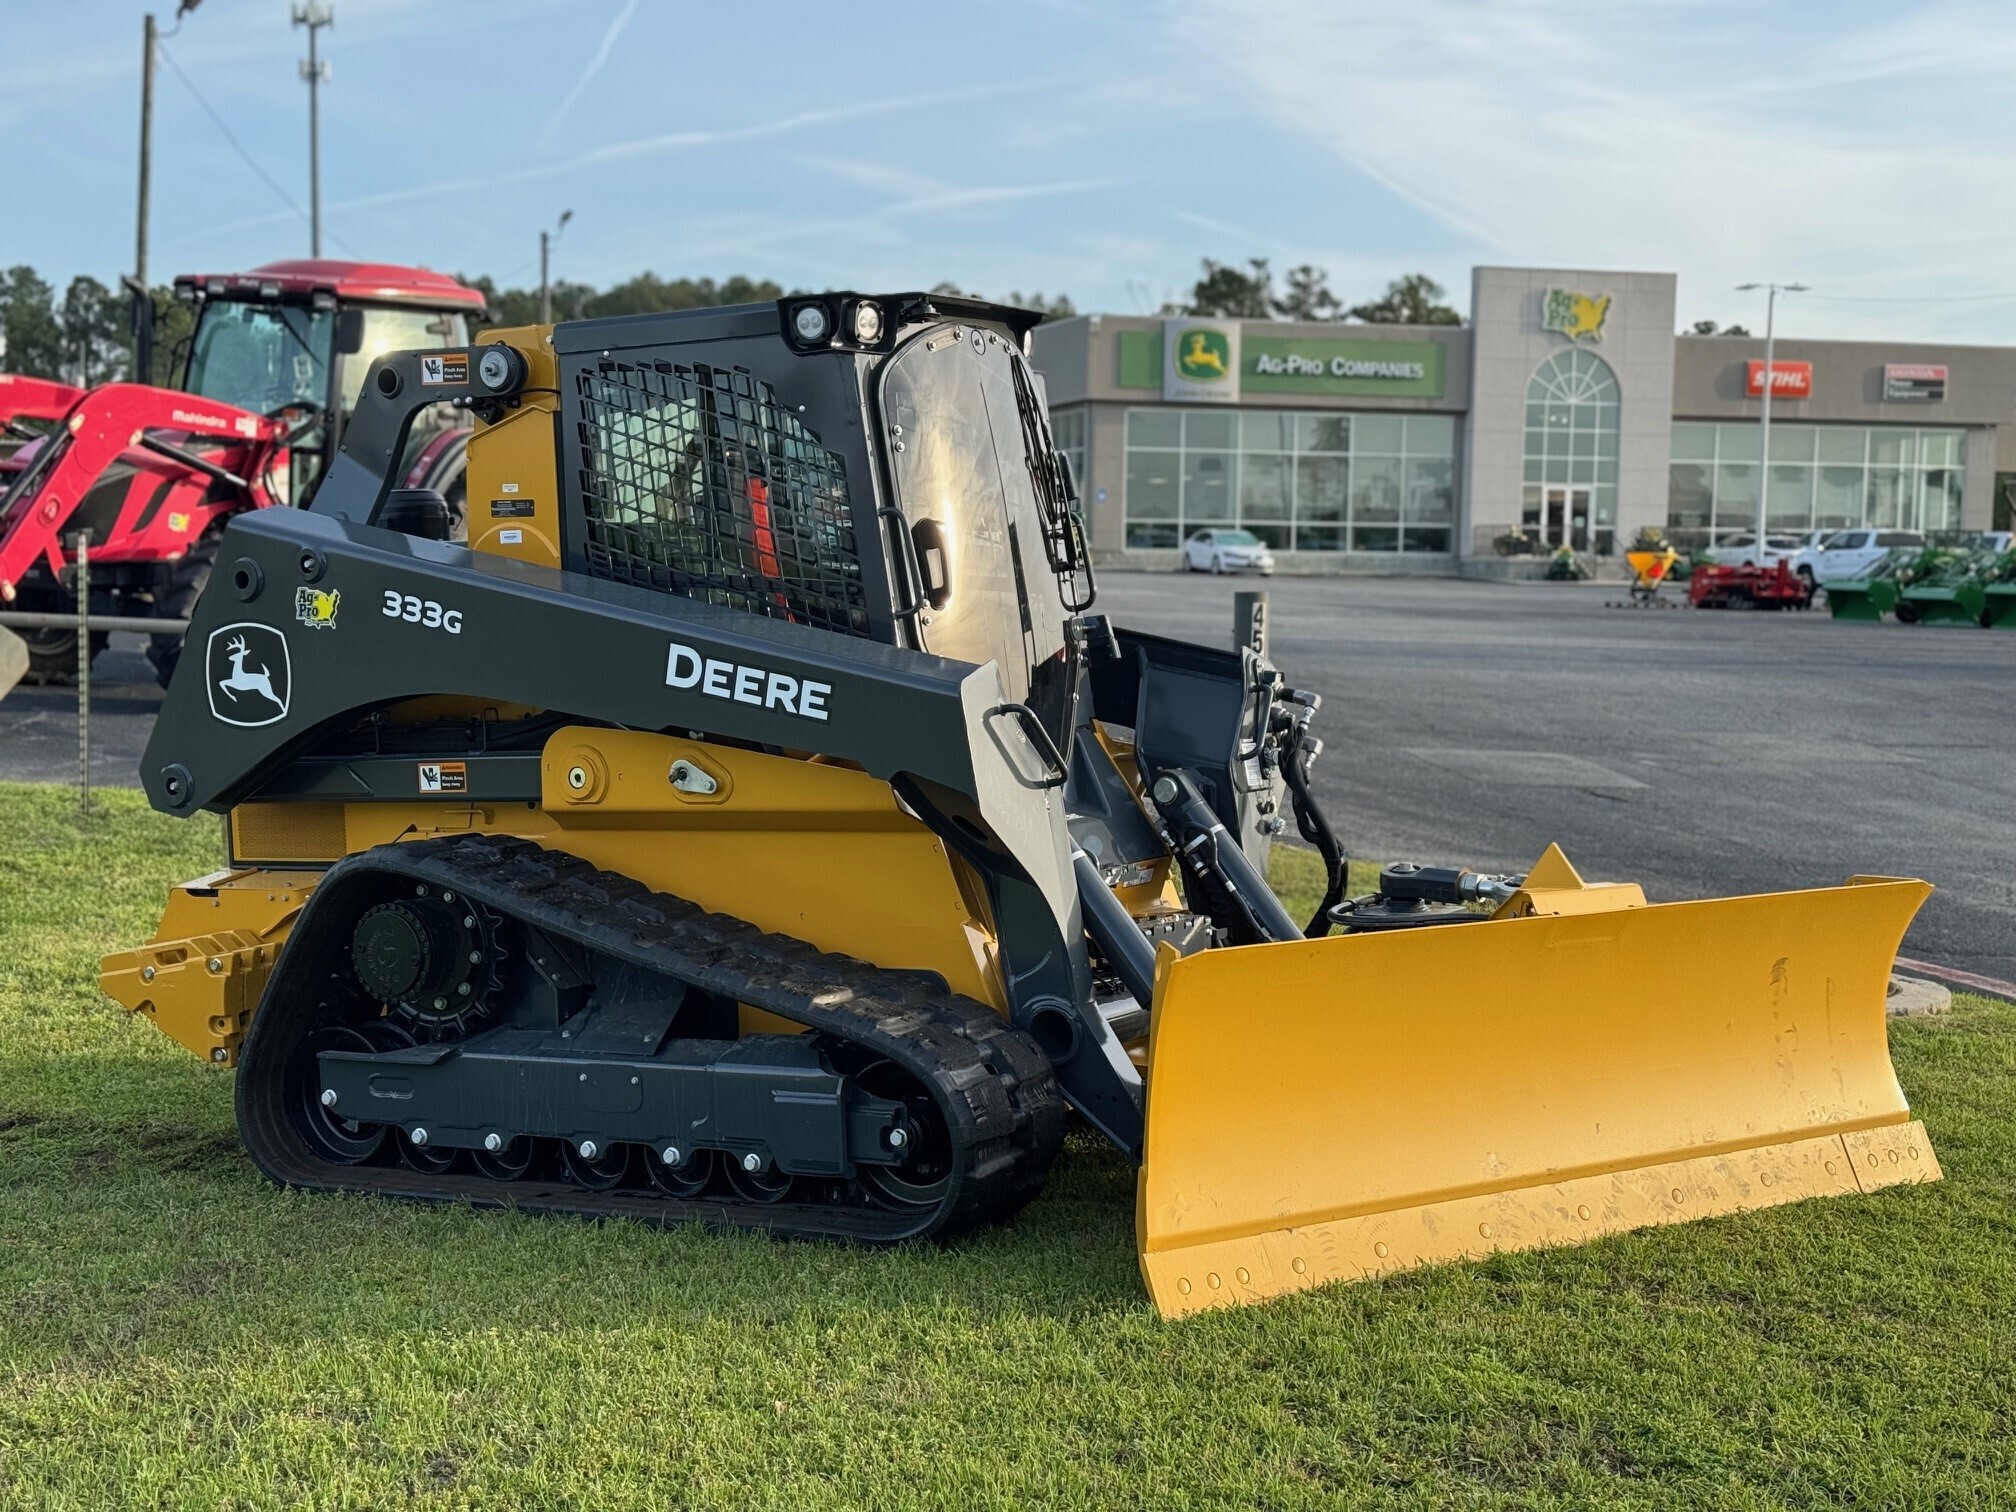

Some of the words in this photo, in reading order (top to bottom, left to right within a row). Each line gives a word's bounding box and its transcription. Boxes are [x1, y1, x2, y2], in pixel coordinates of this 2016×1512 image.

[1548, 310, 1579, 328] Pro
[1752, 370, 1807, 388] STIHL
[299, 603, 319, 618] Pro
[382, 590, 463, 634] 333G
[665, 642, 832, 721] DEERE
